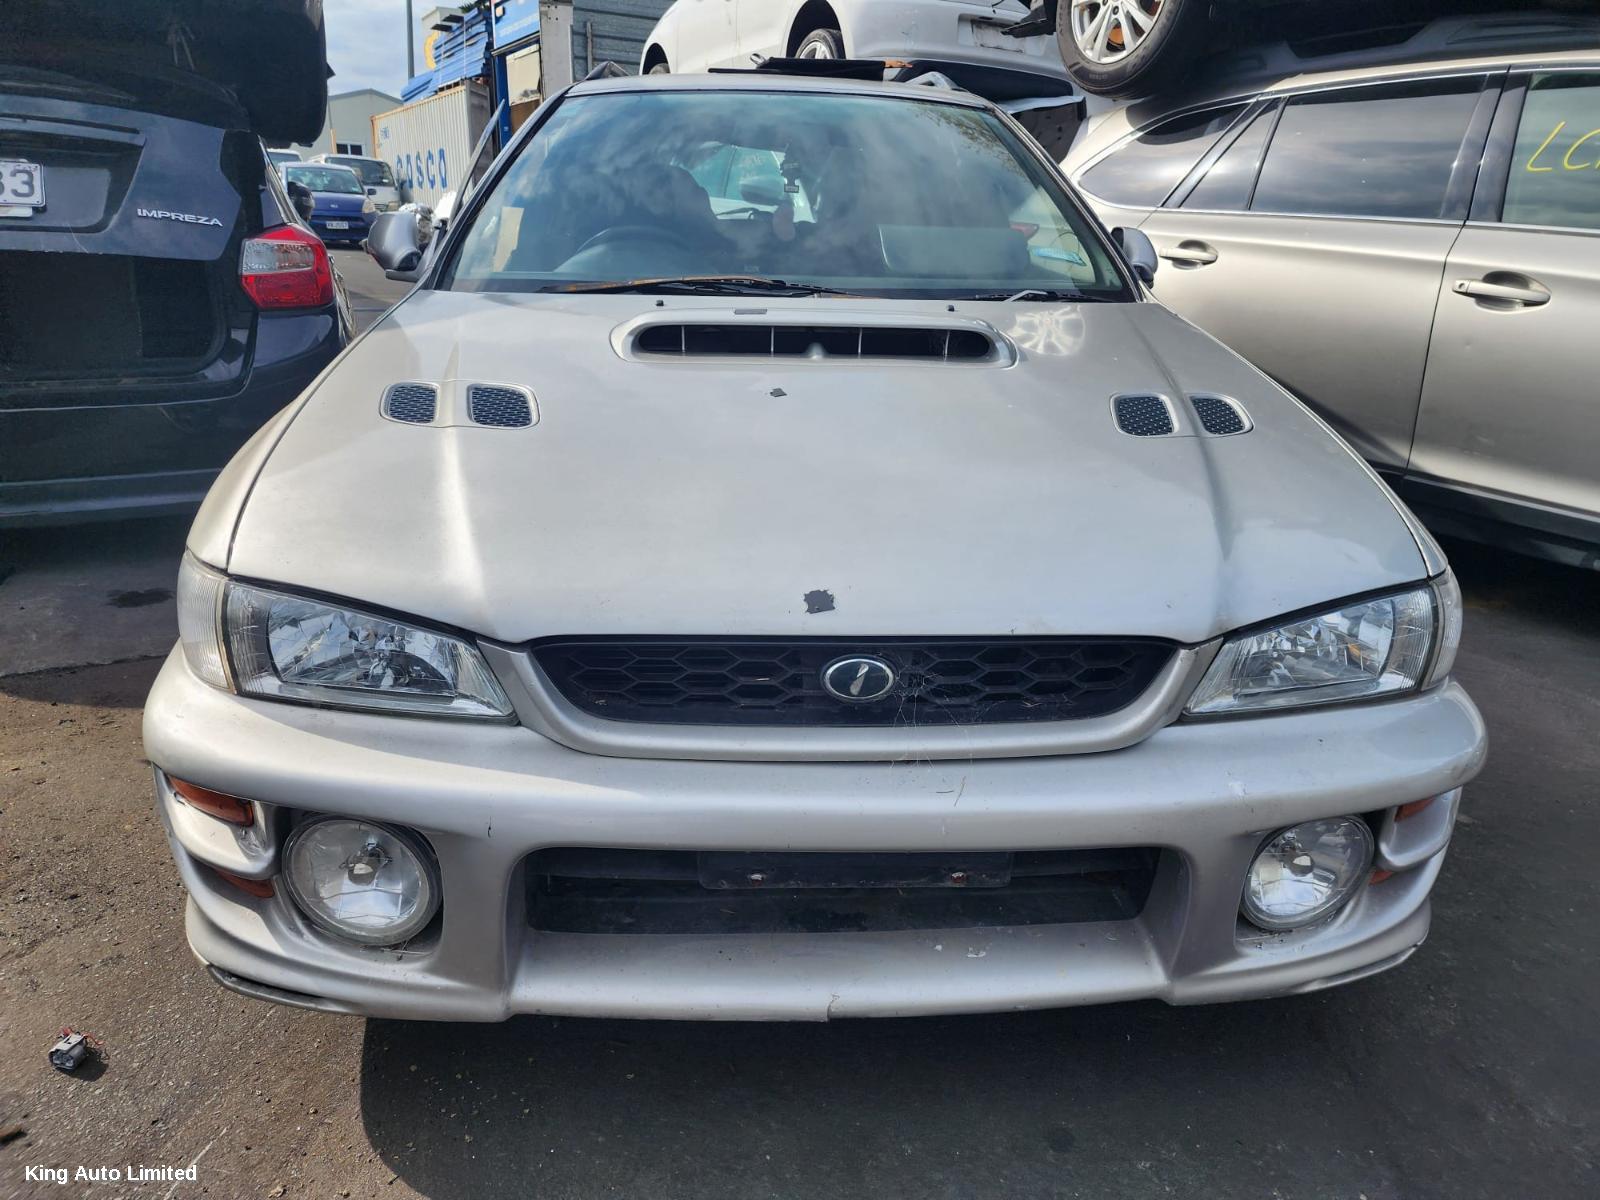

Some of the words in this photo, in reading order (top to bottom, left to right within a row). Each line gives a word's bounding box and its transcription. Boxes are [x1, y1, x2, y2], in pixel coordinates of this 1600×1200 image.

[1526, 121, 1600, 171] LC
[0, 168, 35, 198] 3
[396, 147, 448, 190] COSCO
[137, 208, 223, 227] IMPREZA
